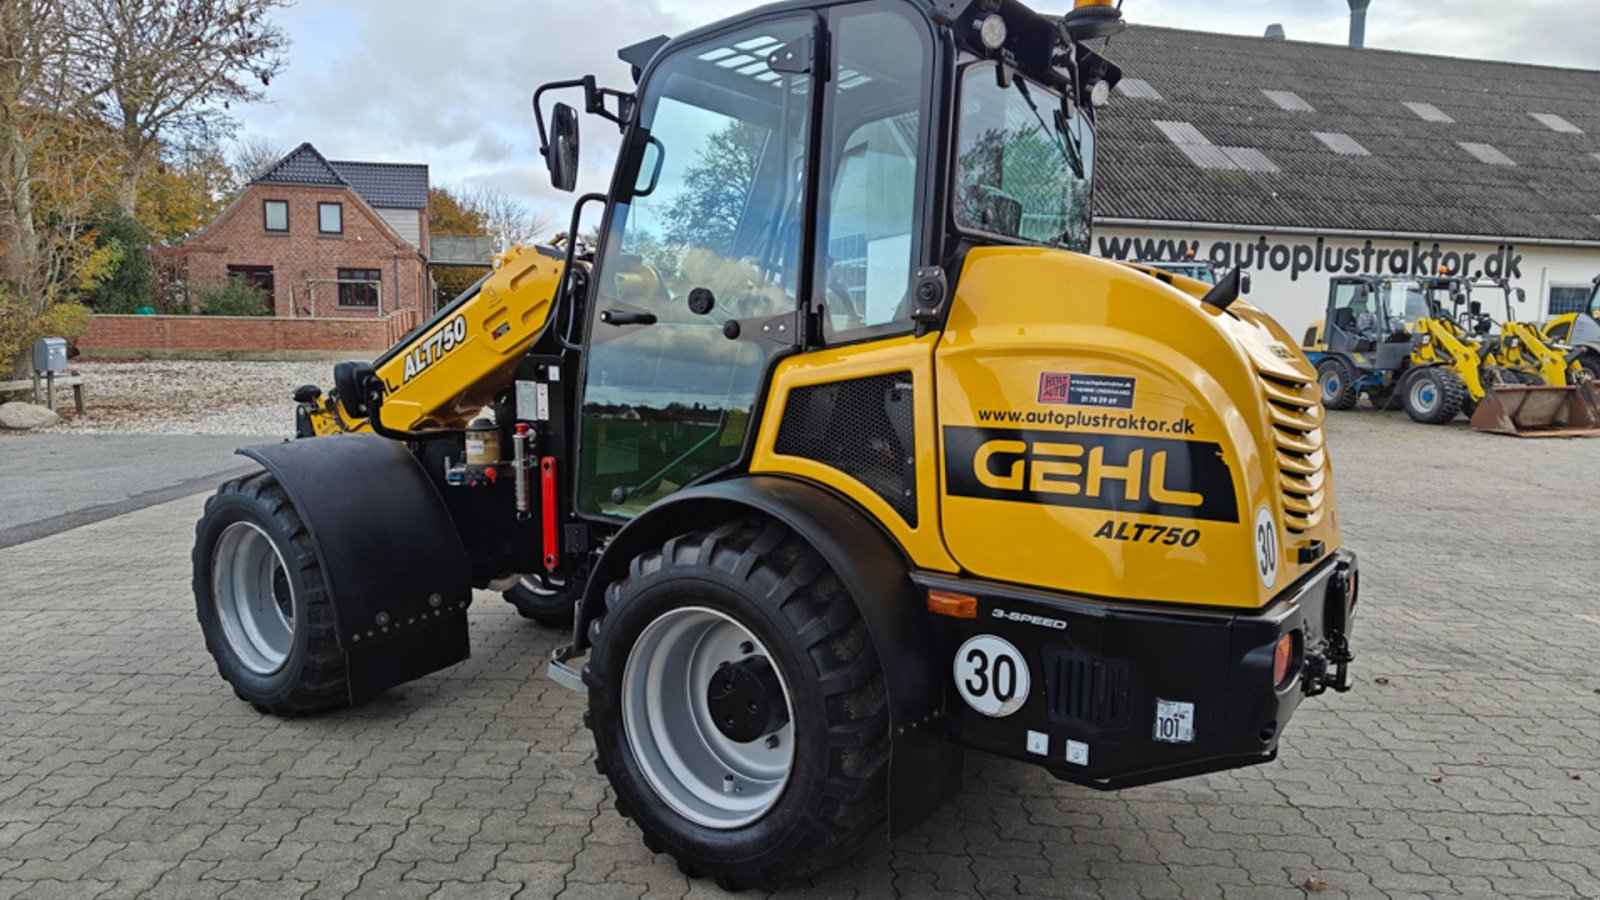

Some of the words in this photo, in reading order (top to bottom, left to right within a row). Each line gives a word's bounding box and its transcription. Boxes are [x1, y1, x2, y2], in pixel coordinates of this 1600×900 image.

[1098, 236, 1522, 281] wwwautoplustraktor.dk
[403, 314, 466, 384] ALT750
[978, 409, 1195, 435] www.autoplustraktor.dk
[973, 439, 1204, 507] GEHL
[1093, 520, 1200, 547] ALT750
[1258, 520, 1276, 576] 30
[992, 608, 1068, 630] 3-SPEED
[964, 648, 1017, 703] 30
[1159, 716, 1179, 738] 101
